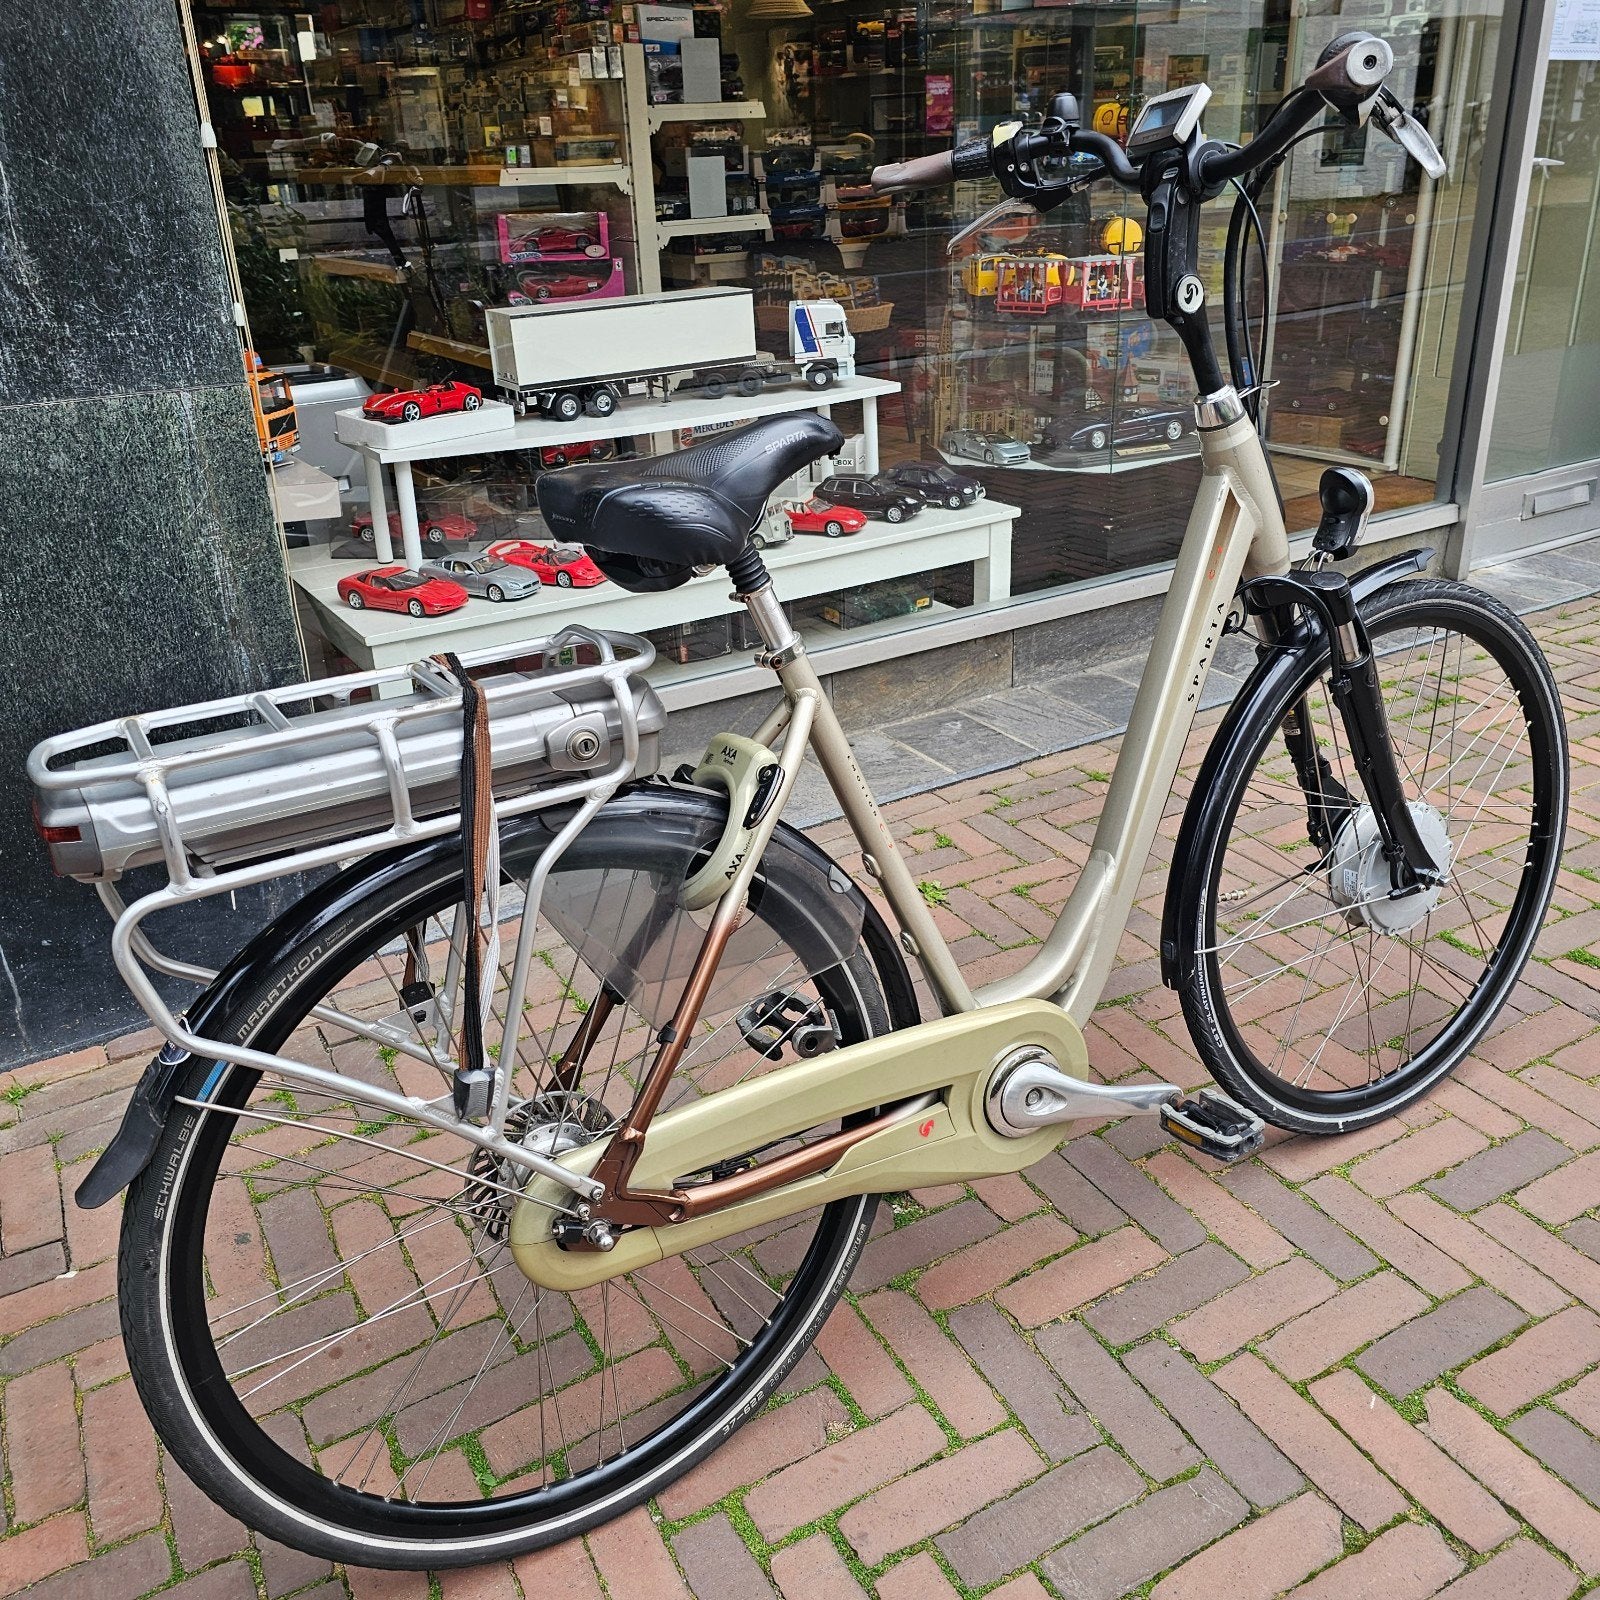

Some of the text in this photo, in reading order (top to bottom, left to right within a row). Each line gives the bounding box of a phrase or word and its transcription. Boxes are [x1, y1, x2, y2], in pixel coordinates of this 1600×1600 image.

[693, 420, 735, 434] MERCEDES
[764, 430, 808, 455] SPARTA
[1187, 602, 1225, 703] SPARTA
[720, 745, 738, 761] AXA
[724, 853, 745, 880] AXA
[236, 945, 322, 1041] MARATHON
[1198, 971, 1215, 1026] PLATINUM
[1210, 1027, 1224, 1049] CST
[154, 1114, 196, 1221] SCHWALBE
[722, 1390, 765, 1435] 37-622
